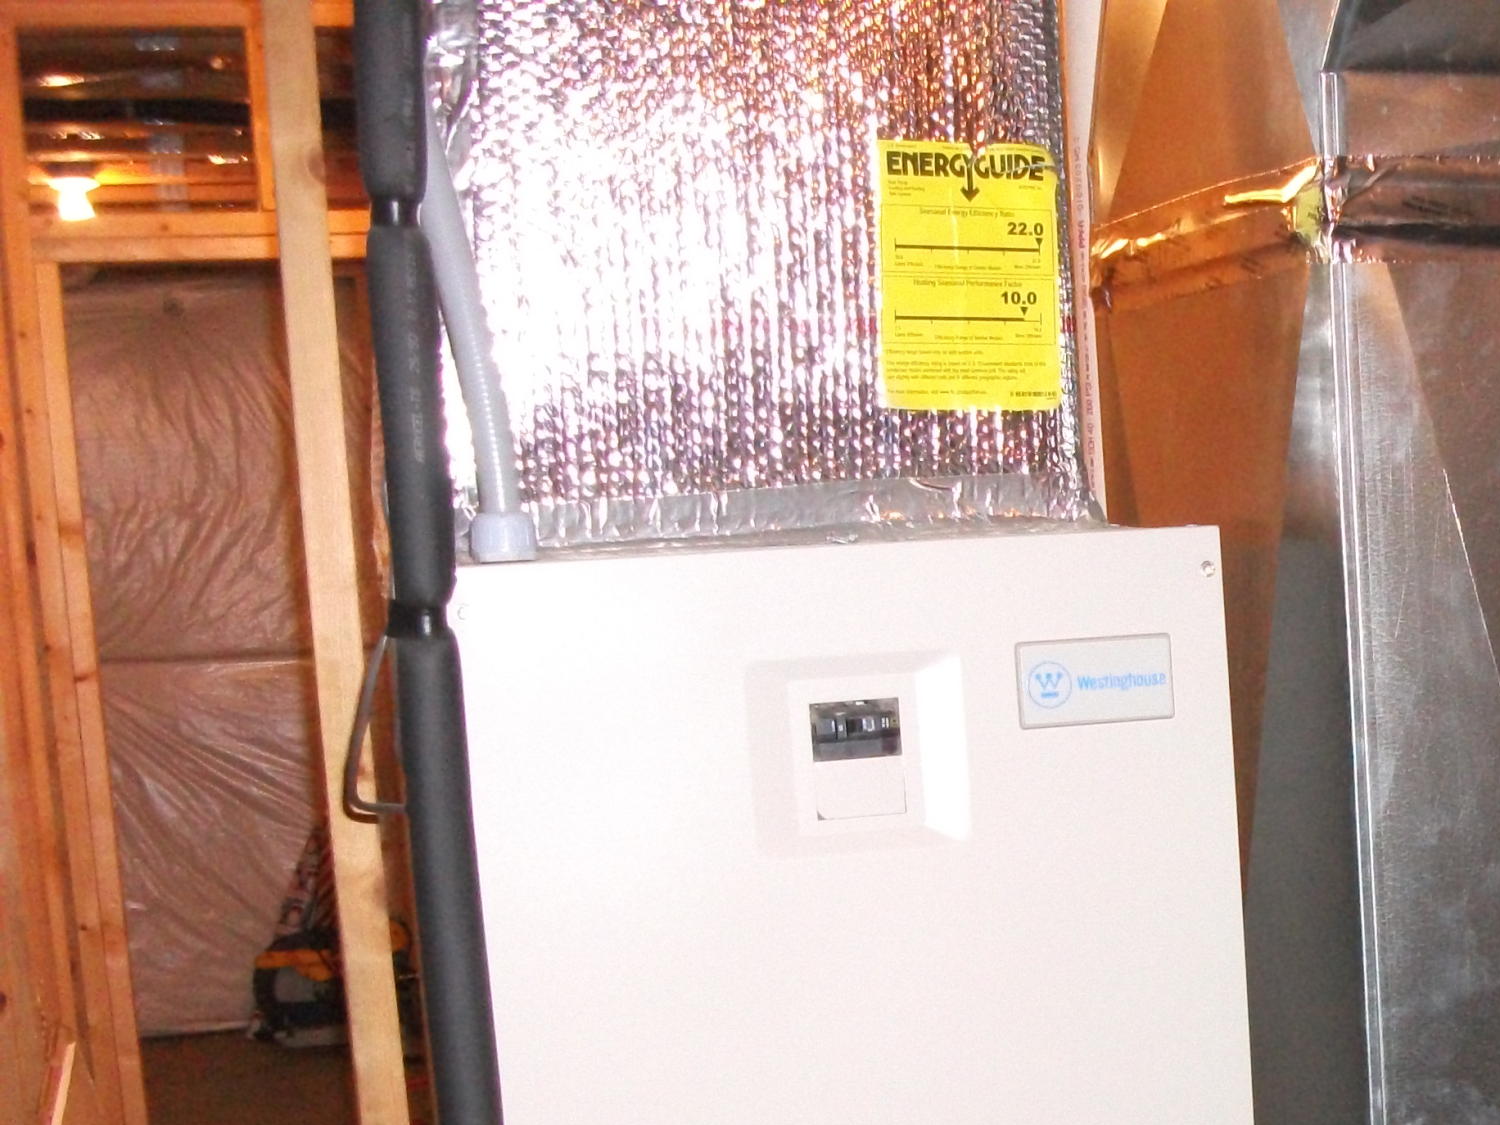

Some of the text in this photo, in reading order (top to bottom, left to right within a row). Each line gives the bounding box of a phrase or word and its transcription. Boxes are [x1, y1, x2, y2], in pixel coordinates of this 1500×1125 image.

[886, 150, 1046, 181] ENERGYGUIDE
[1007, 222, 1044, 236] 22.0
[1001, 291, 1038, 305] 10.0
[1076, 671, 1167, 691] Westinghouse
